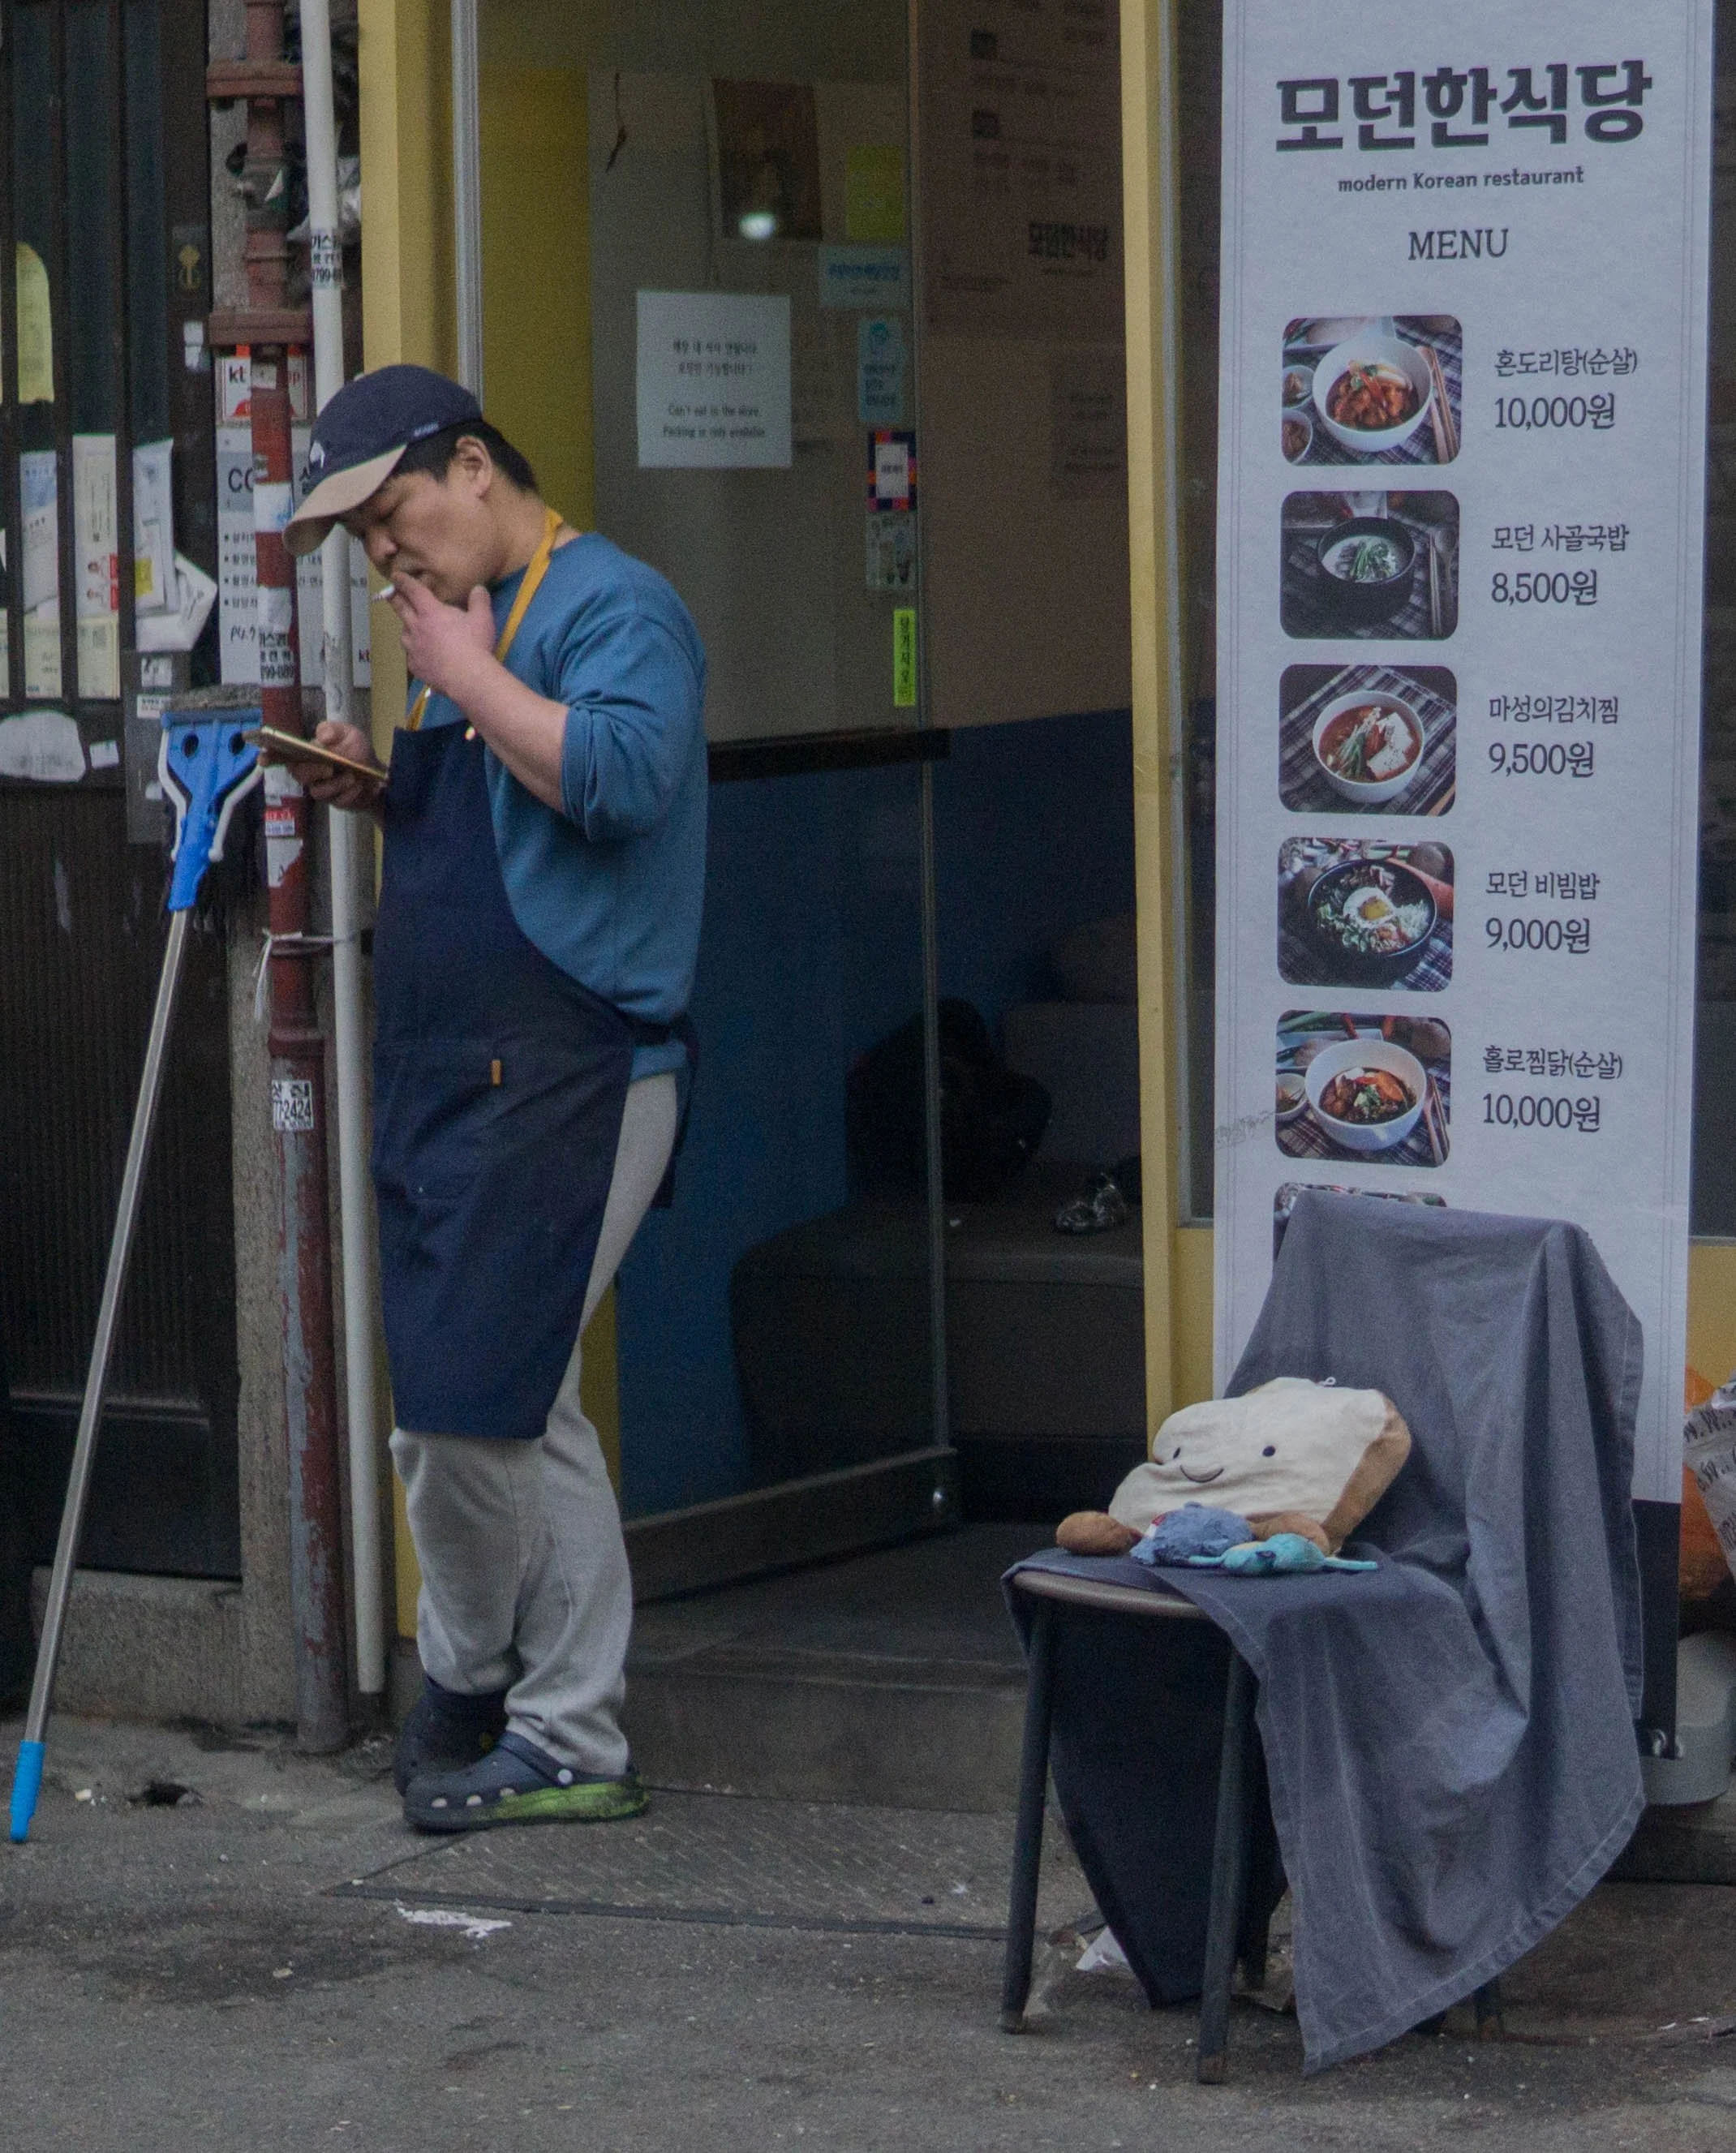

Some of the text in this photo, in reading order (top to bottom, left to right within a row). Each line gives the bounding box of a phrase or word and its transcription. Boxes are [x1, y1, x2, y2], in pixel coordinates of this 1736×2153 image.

[1276, 60, 1652, 152] 모던한식당
[1338, 165, 1584, 192] modern Korean restaurant
[1407, 228, 1509, 260] MENU
[229, 366, 246, 383] kt
[1494, 347, 1638, 377] 혼도리탕(순살)
[1494, 392, 1615, 431] 10,000원
[1491, 524, 1630, 552] 모던 사골국밥
[1491, 569, 1597, 606] 8,500원
[1489, 695, 1618, 724] 마성의김치찜
[1489, 741, 1594, 778] 9,500원
[1485, 870, 1601, 900] 모던 비빔밥
[1485, 917, 1591, 954] 9,000원
[1483, 1045, 1622, 1080] 홀로찜닭(순살)
[1483, 1094, 1600, 1132] 10,000원
